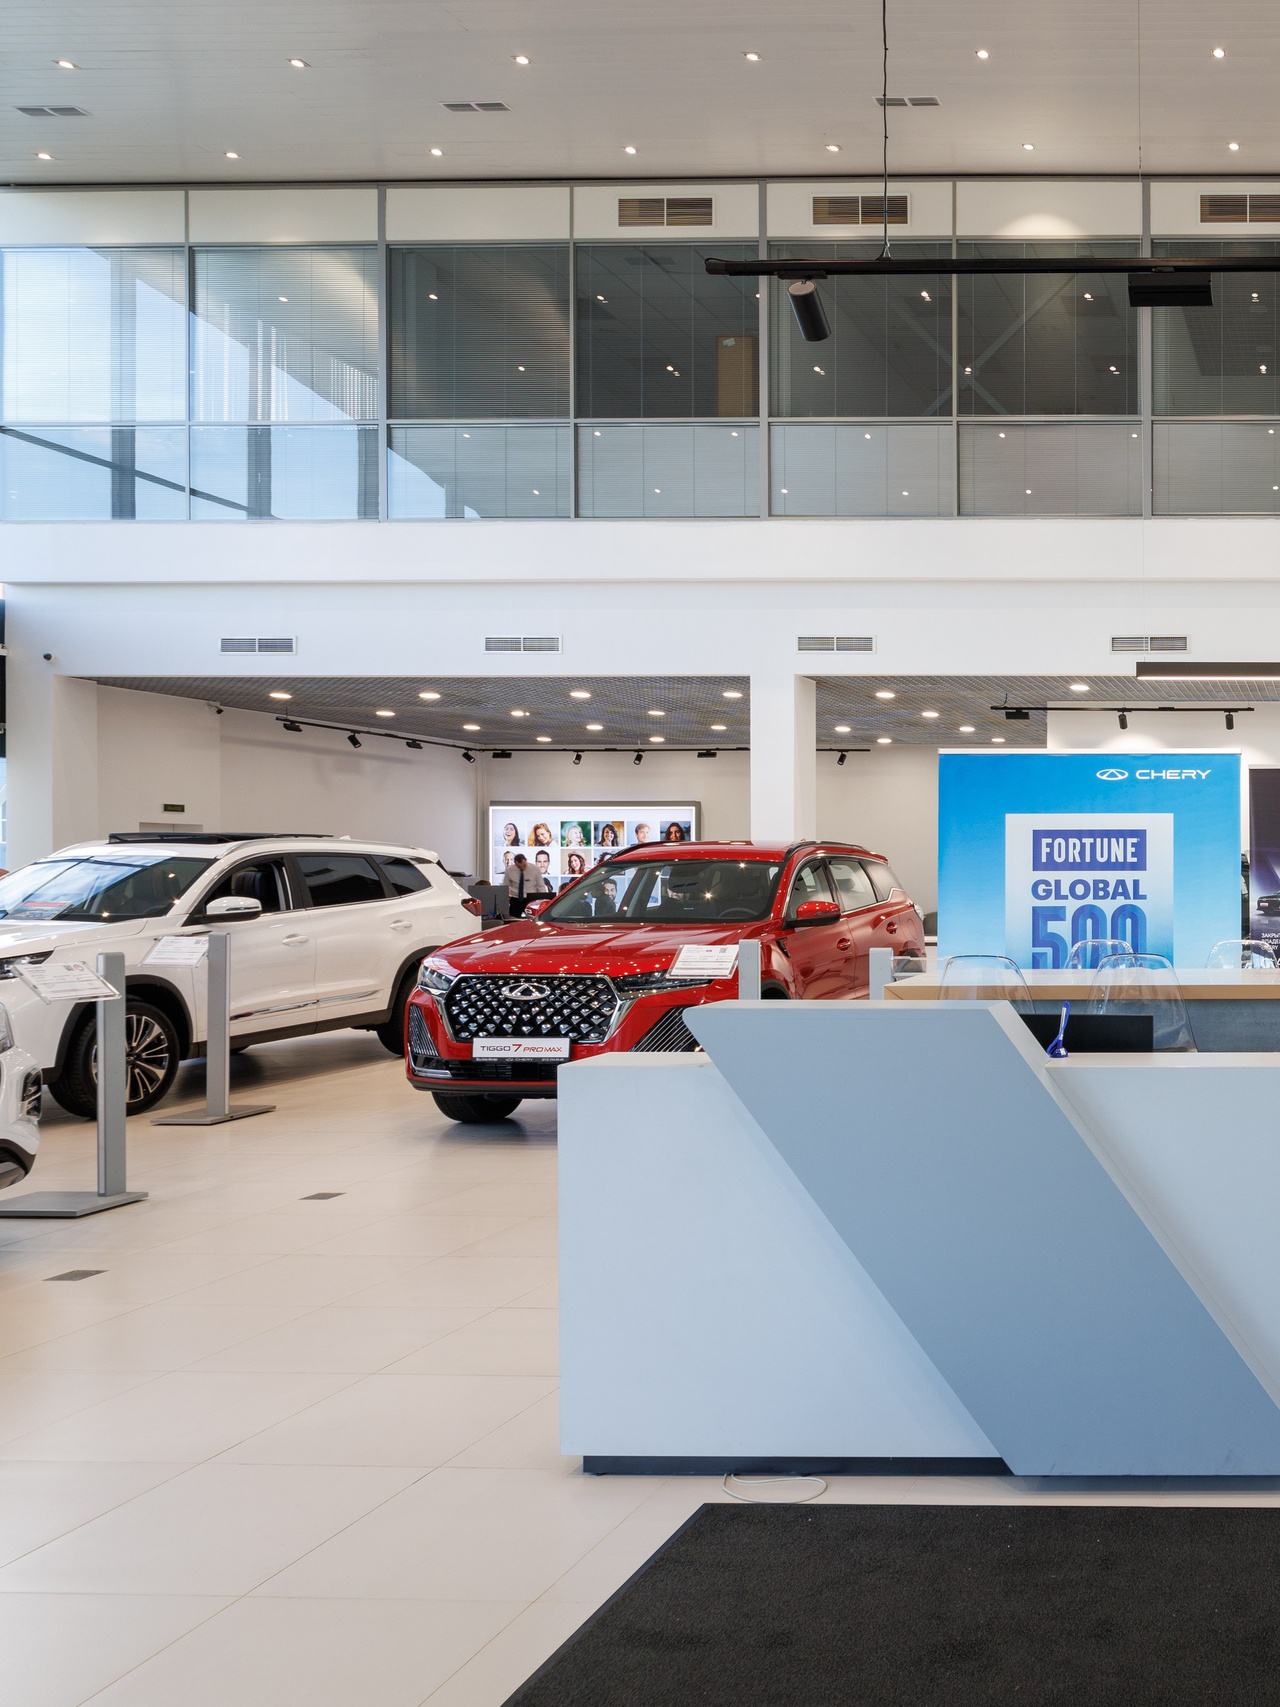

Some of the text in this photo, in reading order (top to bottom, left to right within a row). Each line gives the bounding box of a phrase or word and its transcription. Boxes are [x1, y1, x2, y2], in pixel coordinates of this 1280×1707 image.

[1136, 770, 1212, 780] CHERY
[1041, 838, 1138, 863] FORTUNE
[1031, 879, 1147, 900] GLOBAL
[1032, 904, 1147, 969] 500
[512, 1044, 522, 1052] 7
